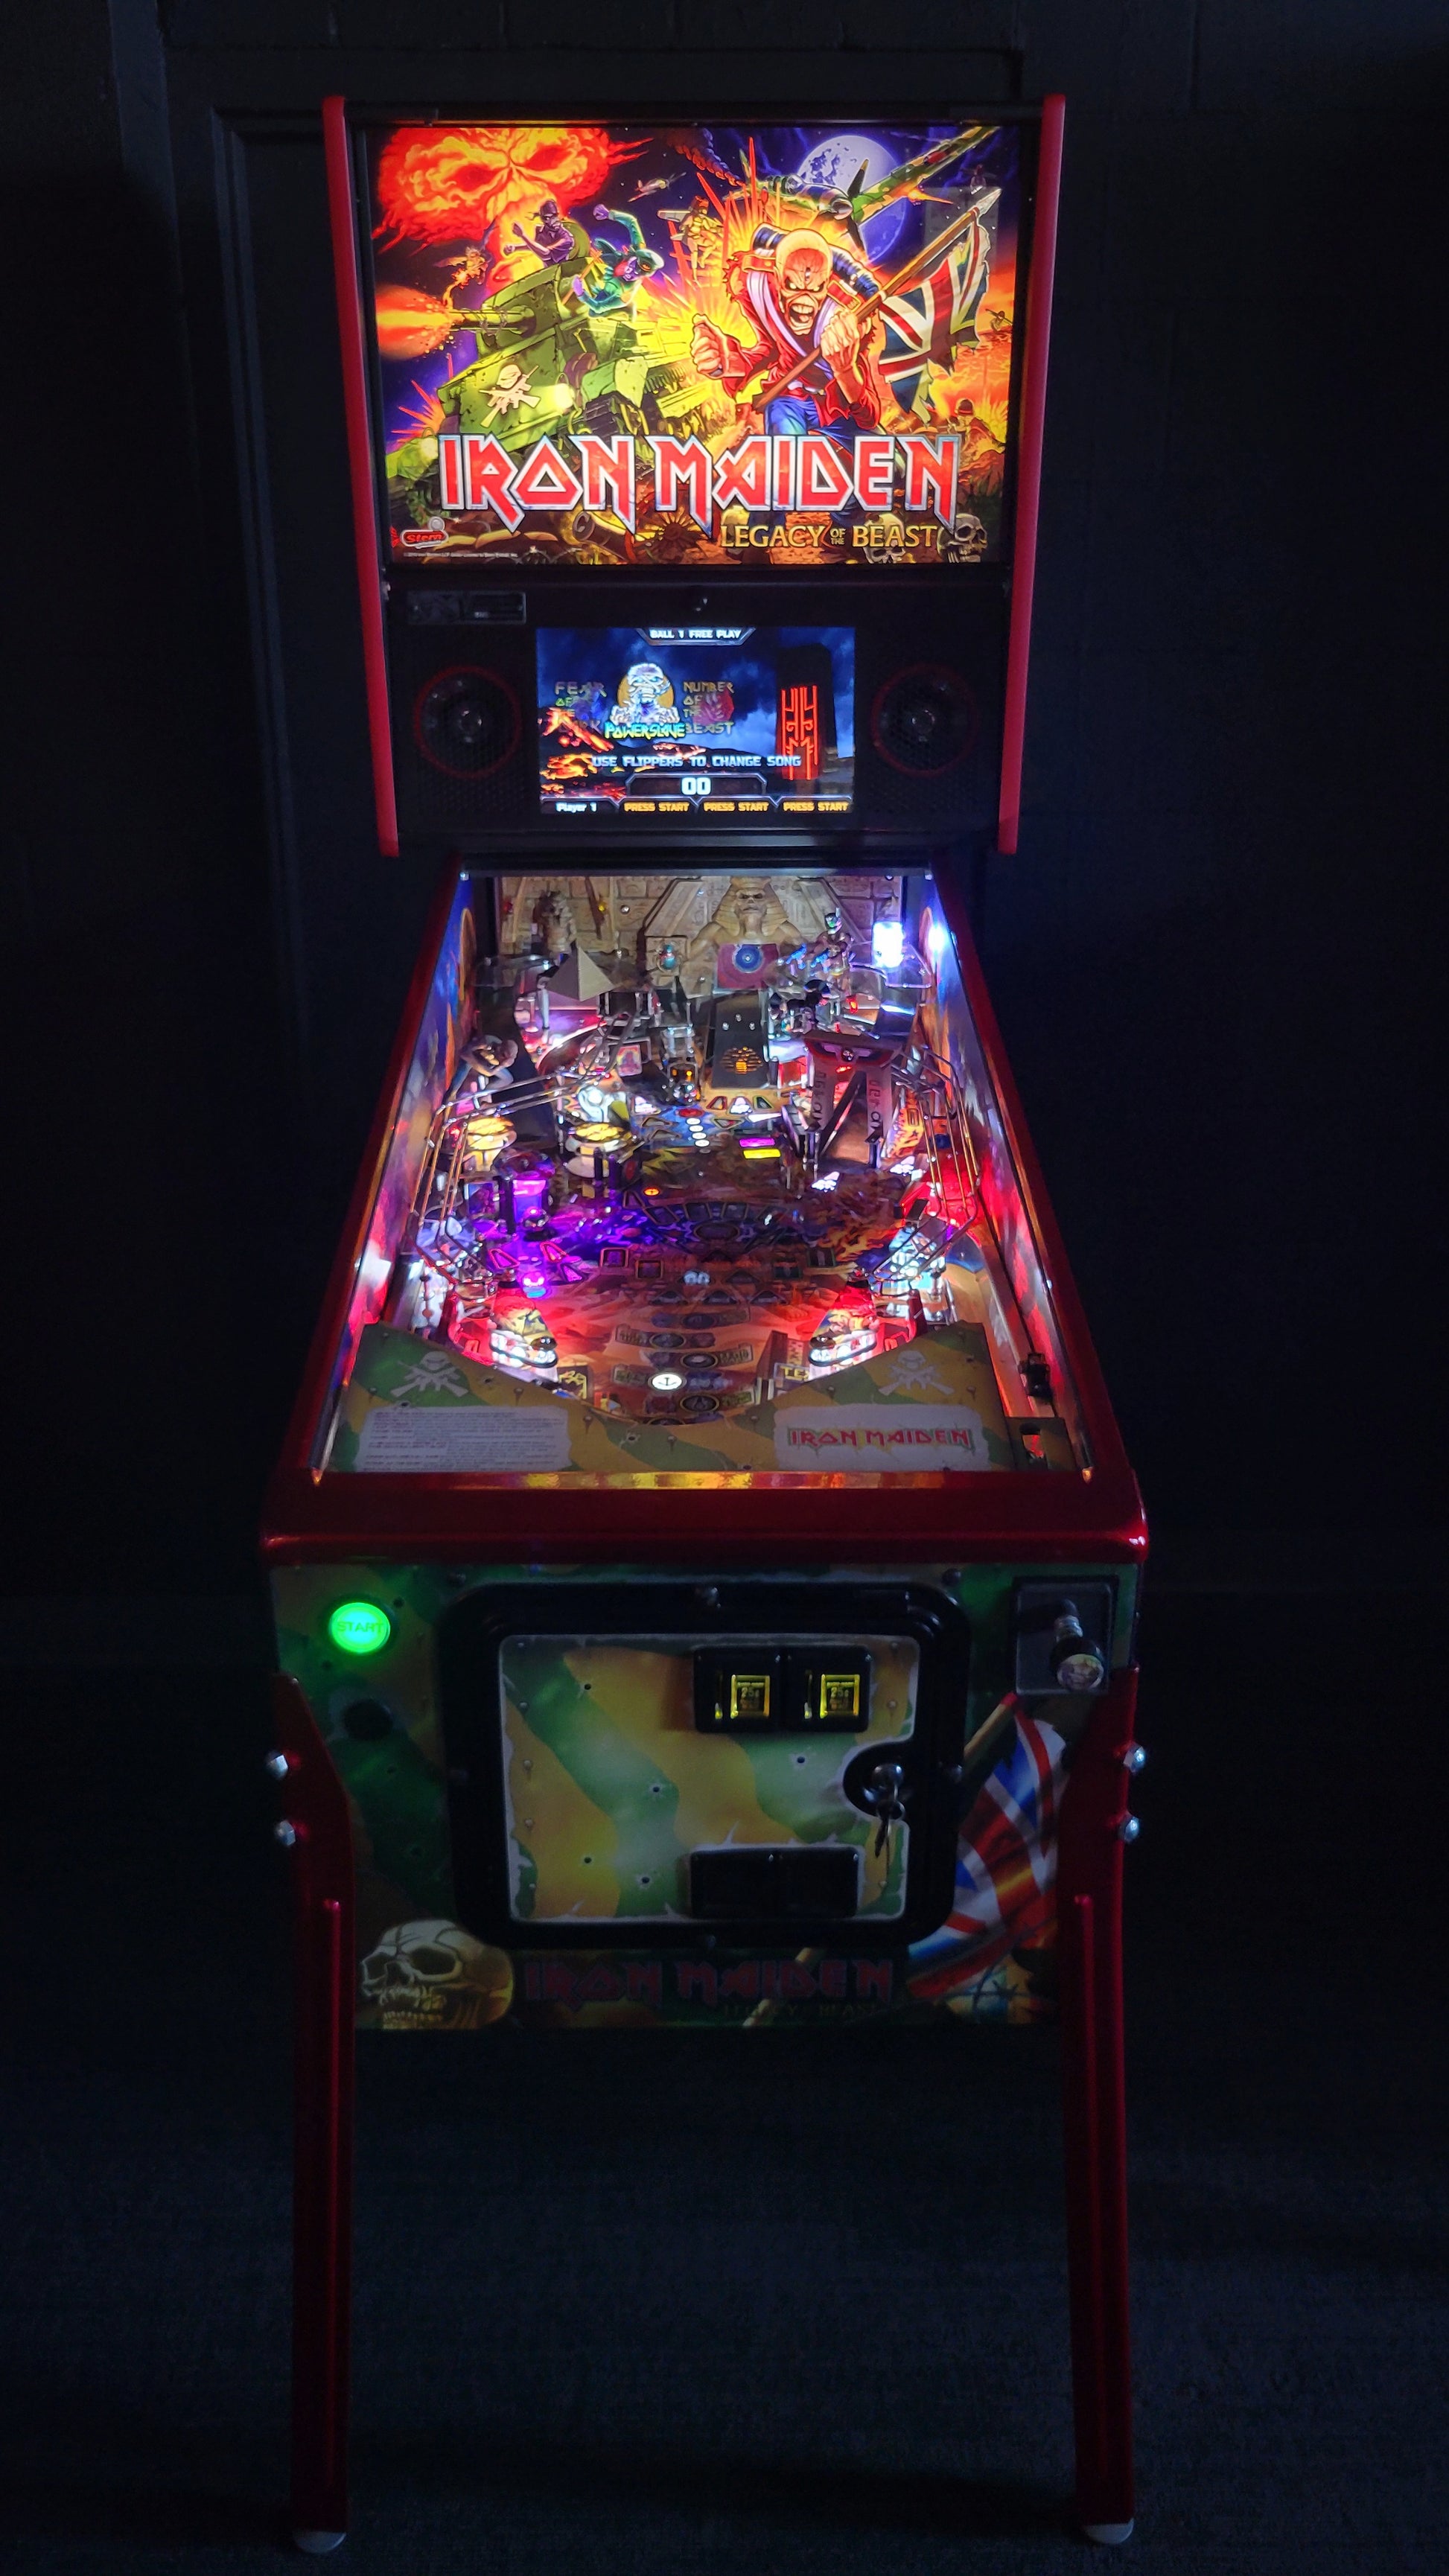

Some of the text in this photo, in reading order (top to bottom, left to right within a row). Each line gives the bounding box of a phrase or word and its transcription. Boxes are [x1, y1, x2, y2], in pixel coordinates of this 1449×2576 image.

[437, 432, 962, 538] IRON MAIDEN
[406, 532, 443, 543] Stern
[720, 525, 938, 548] LEGACY OF BEAST
[830, 537, 845, 546] THE
[649, 628, 742, 639] BALL 1 FREE PLAY
[554, 680, 608, 697] FEAR
[683, 681, 735, 694] NUMBER
[683, 695, 704, 706] OF
[604, 721, 687, 741] POWERSLAVE
[685, 721, 735, 735] BEAST
[592, 756, 802, 768] USE FLIPPERS TO CHANGE SONG
[681, 777, 712, 796] 00
[555, 802, 597, 814] Player 1
[623, 801, 690, 812] PRESS START
[703, 801, 770, 812] PRESS START
[783, 801, 850, 812] PRESS START
[789, 1428, 971, 1450] IRON MAIDEN
[336, 1620, 384, 1633] START
[523, 1960, 893, 2012] IRON MAIDEN
